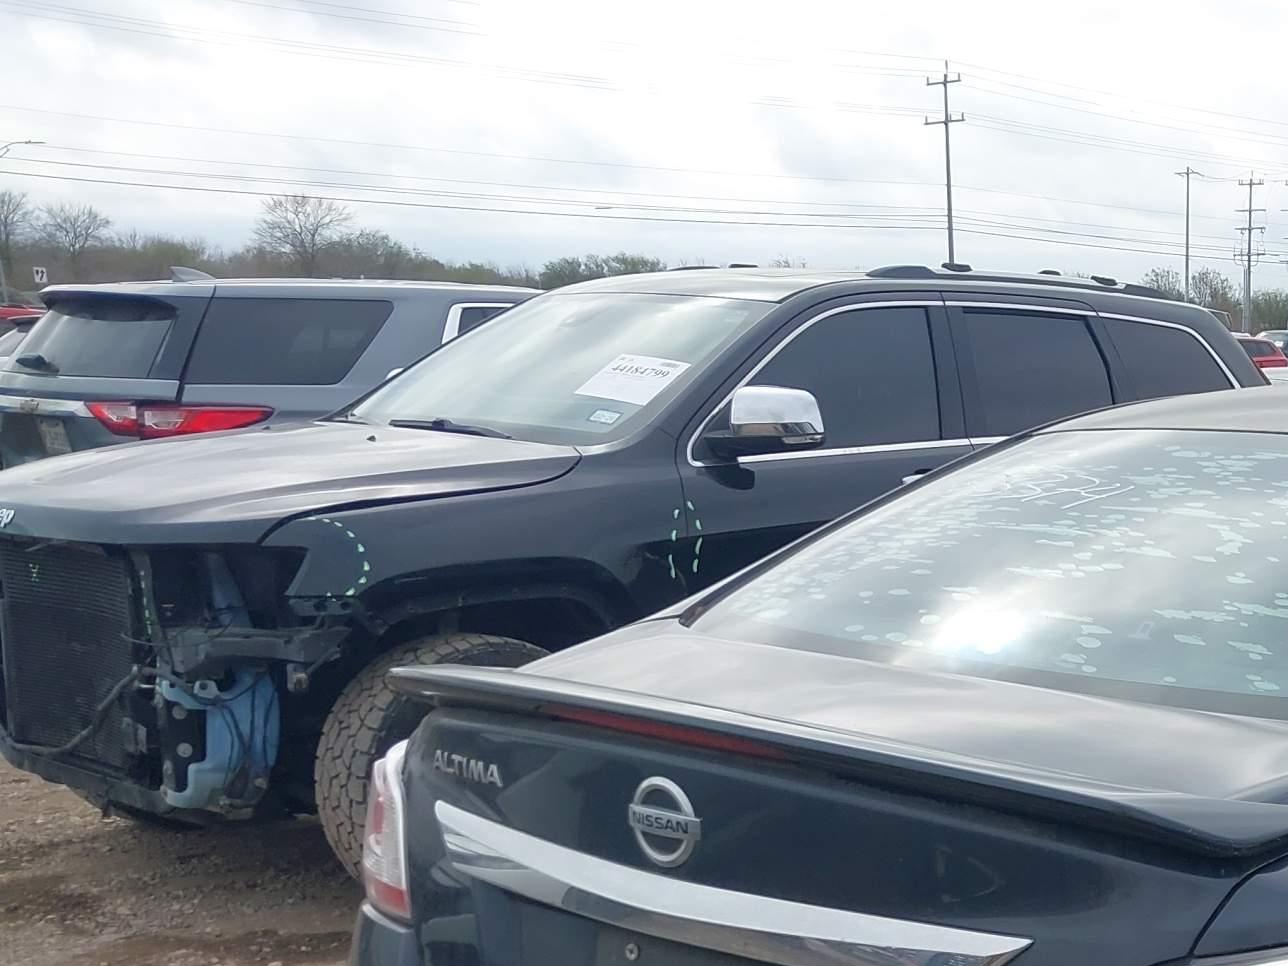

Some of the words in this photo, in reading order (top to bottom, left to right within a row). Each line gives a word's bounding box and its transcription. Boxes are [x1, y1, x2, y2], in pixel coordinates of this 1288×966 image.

[611, 364, 671, 378] 44184799
[433, 749, 504, 788] ALTIMA
[631, 808, 689, 835] NISSAN
